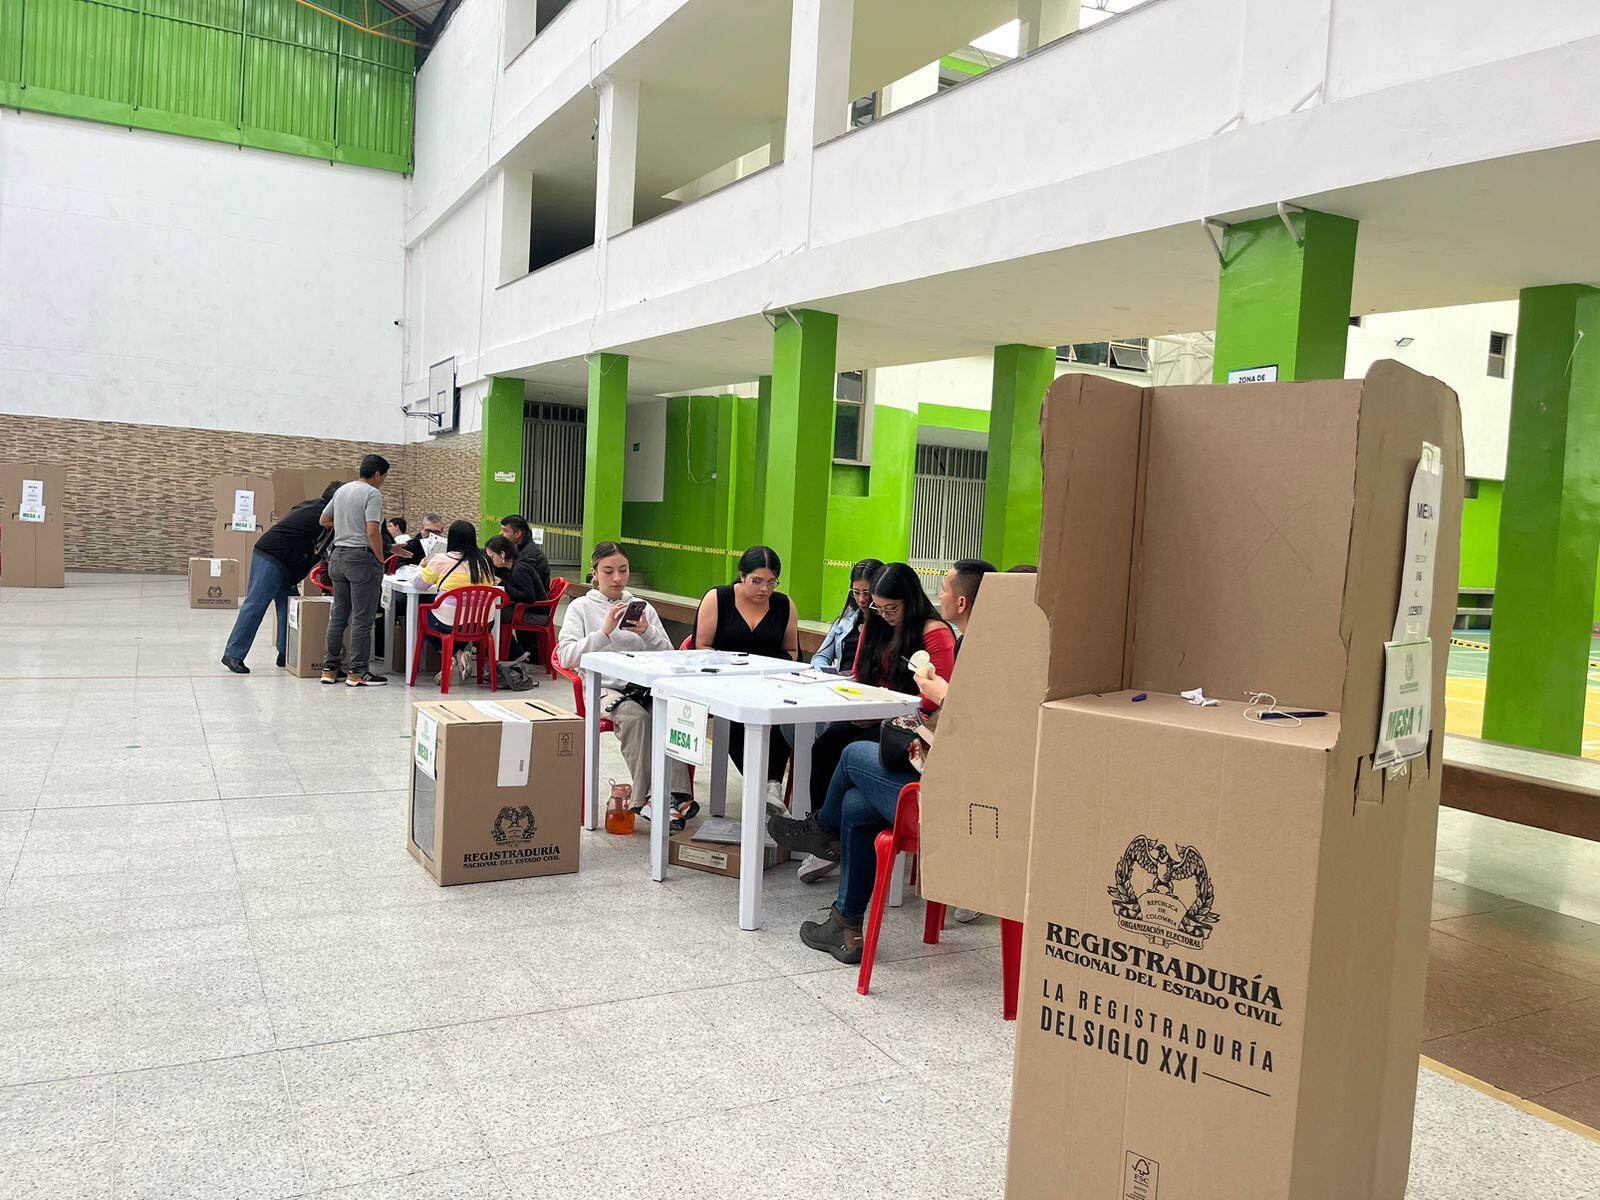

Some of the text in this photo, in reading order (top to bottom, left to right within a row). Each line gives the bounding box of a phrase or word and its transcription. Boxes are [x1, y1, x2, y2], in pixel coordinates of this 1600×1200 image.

[1239, 375, 1256, 383] ZONA
[1385, 705, 1423, 742] MESA 1
[669, 728, 698, 753] MESA 1
[463, 843, 561, 863] REGISTRADURÍA
[463, 860, 498, 869] NACIONAL
[515, 856, 542, 865] ESTADO
[1120, 919, 1201, 948] ORGANIZACIÓN ELECTORAL
[1145, 914, 1177, 927] COLOMBIA
[1046, 921, 1283, 1010] REGISTRADURÍA
[1045, 944, 1282, 1027] NACIONAL DEL ESTADO CIVIL
[1042, 978, 1273, 1073] LA REGISTRADURÍA
[1159, 1044, 1198, 1084] XXI
